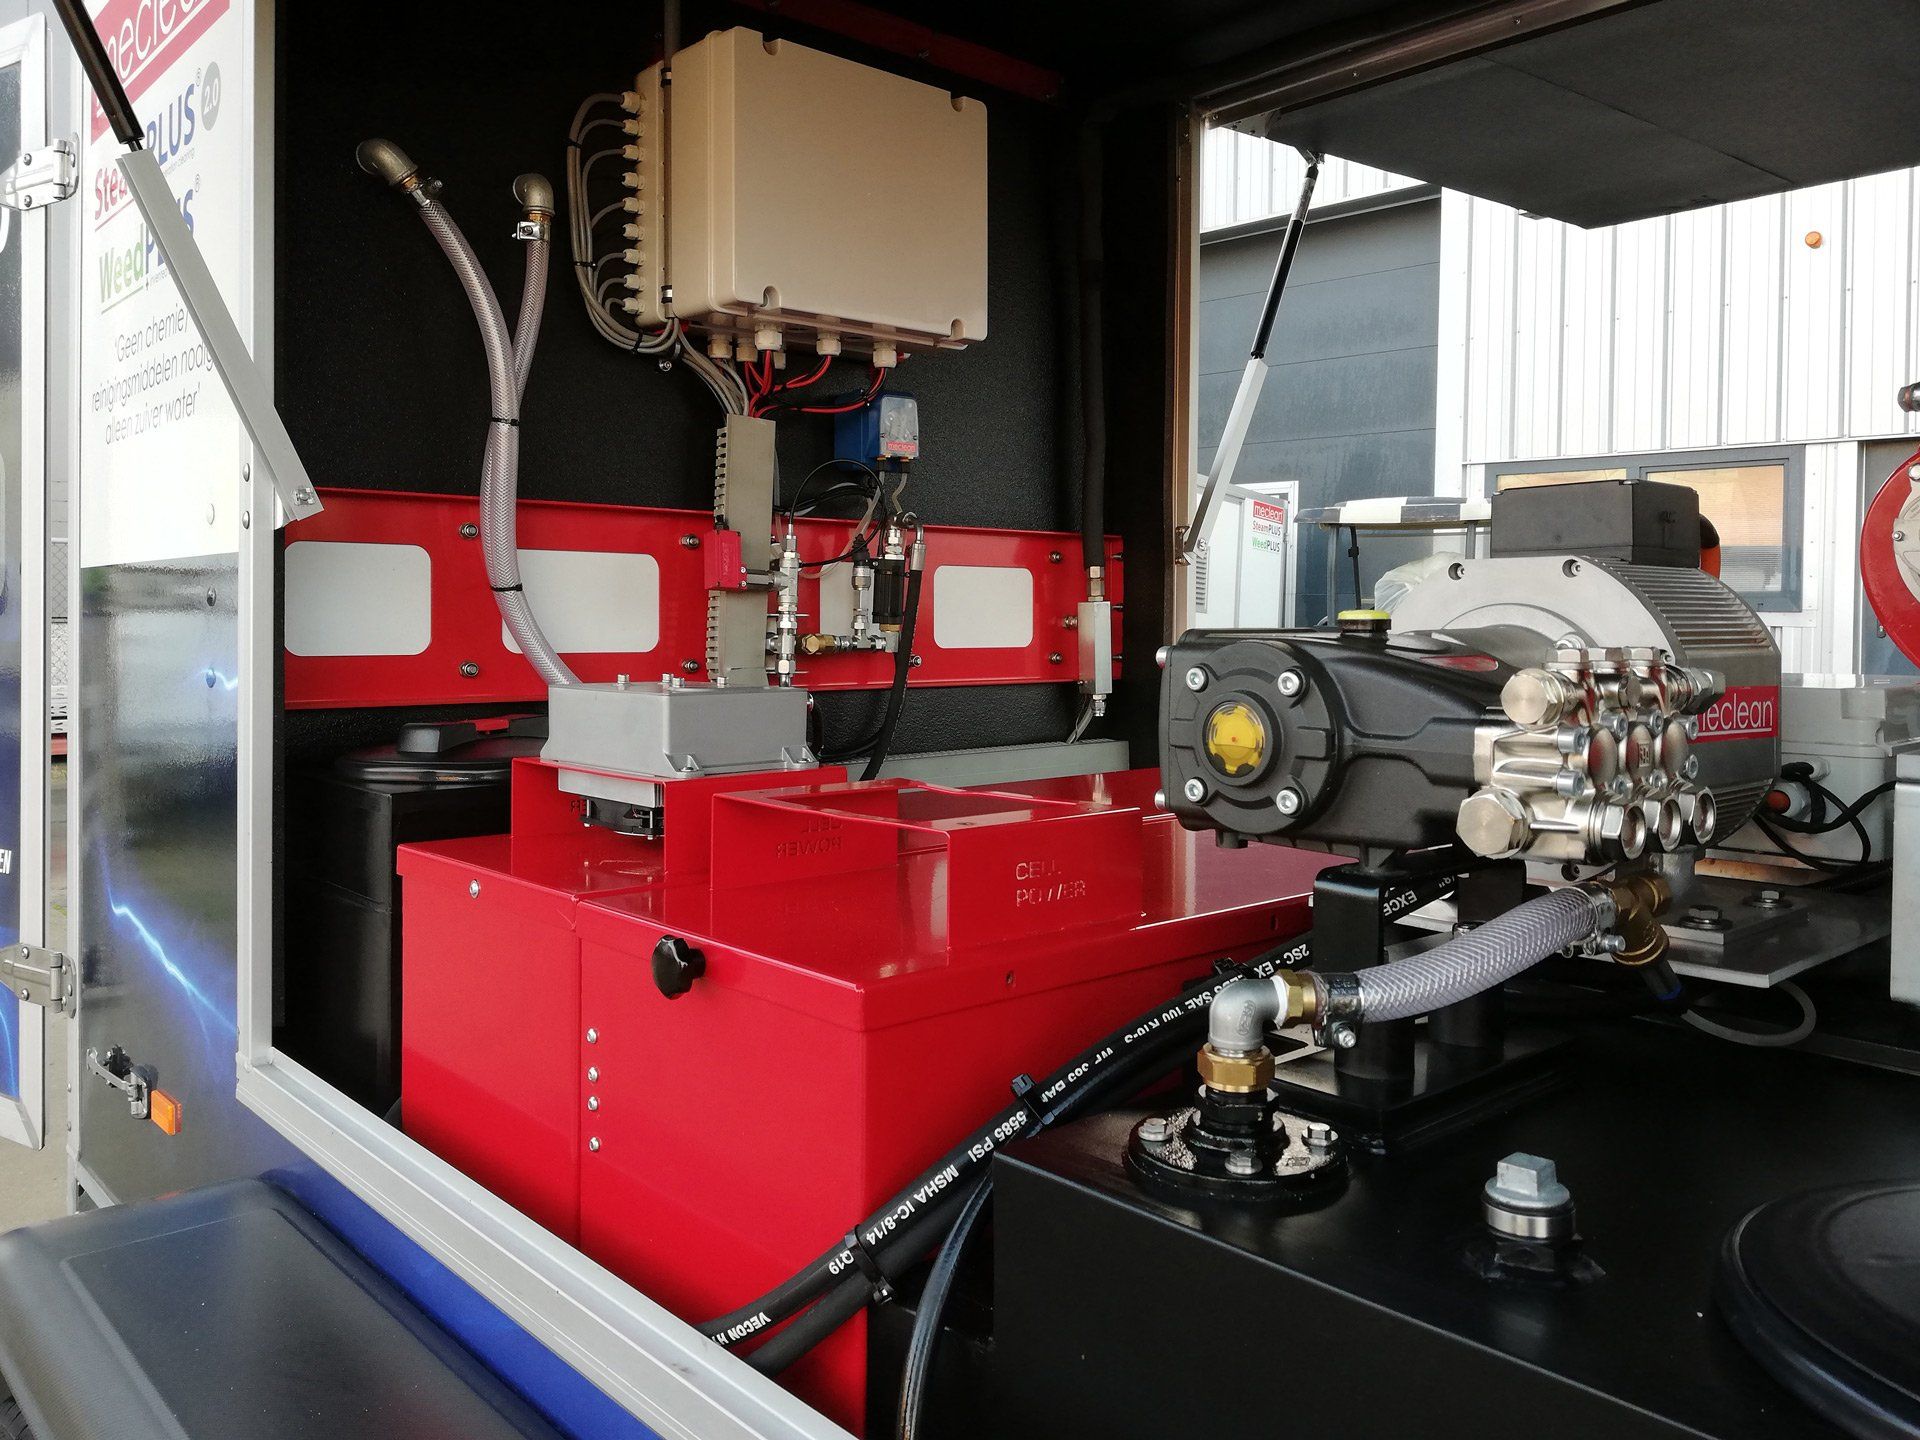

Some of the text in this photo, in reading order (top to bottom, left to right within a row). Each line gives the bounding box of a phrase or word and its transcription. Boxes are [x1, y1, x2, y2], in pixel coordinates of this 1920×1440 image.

[203, 78, 219, 115] 2.0
[105, 415, 132, 445] alleen
[134, 403, 163, 436] zuiver
[1254, 505, 1283, 523] meclean
[1702, 693, 1773, 731] eclean
[1283, 943, 1310, 965] 2SC
[1185, 991, 1213, 1010] SAE
[994, 1111, 1027, 1142] 5585
[967, 1136, 994, 1162] PSI
[913, 1164, 959, 1204] MSHA
[866, 1200, 915, 1245] IC-8/14
[828, 1250, 854, 1275] Q19
[727, 1311, 772, 1341] VECON
